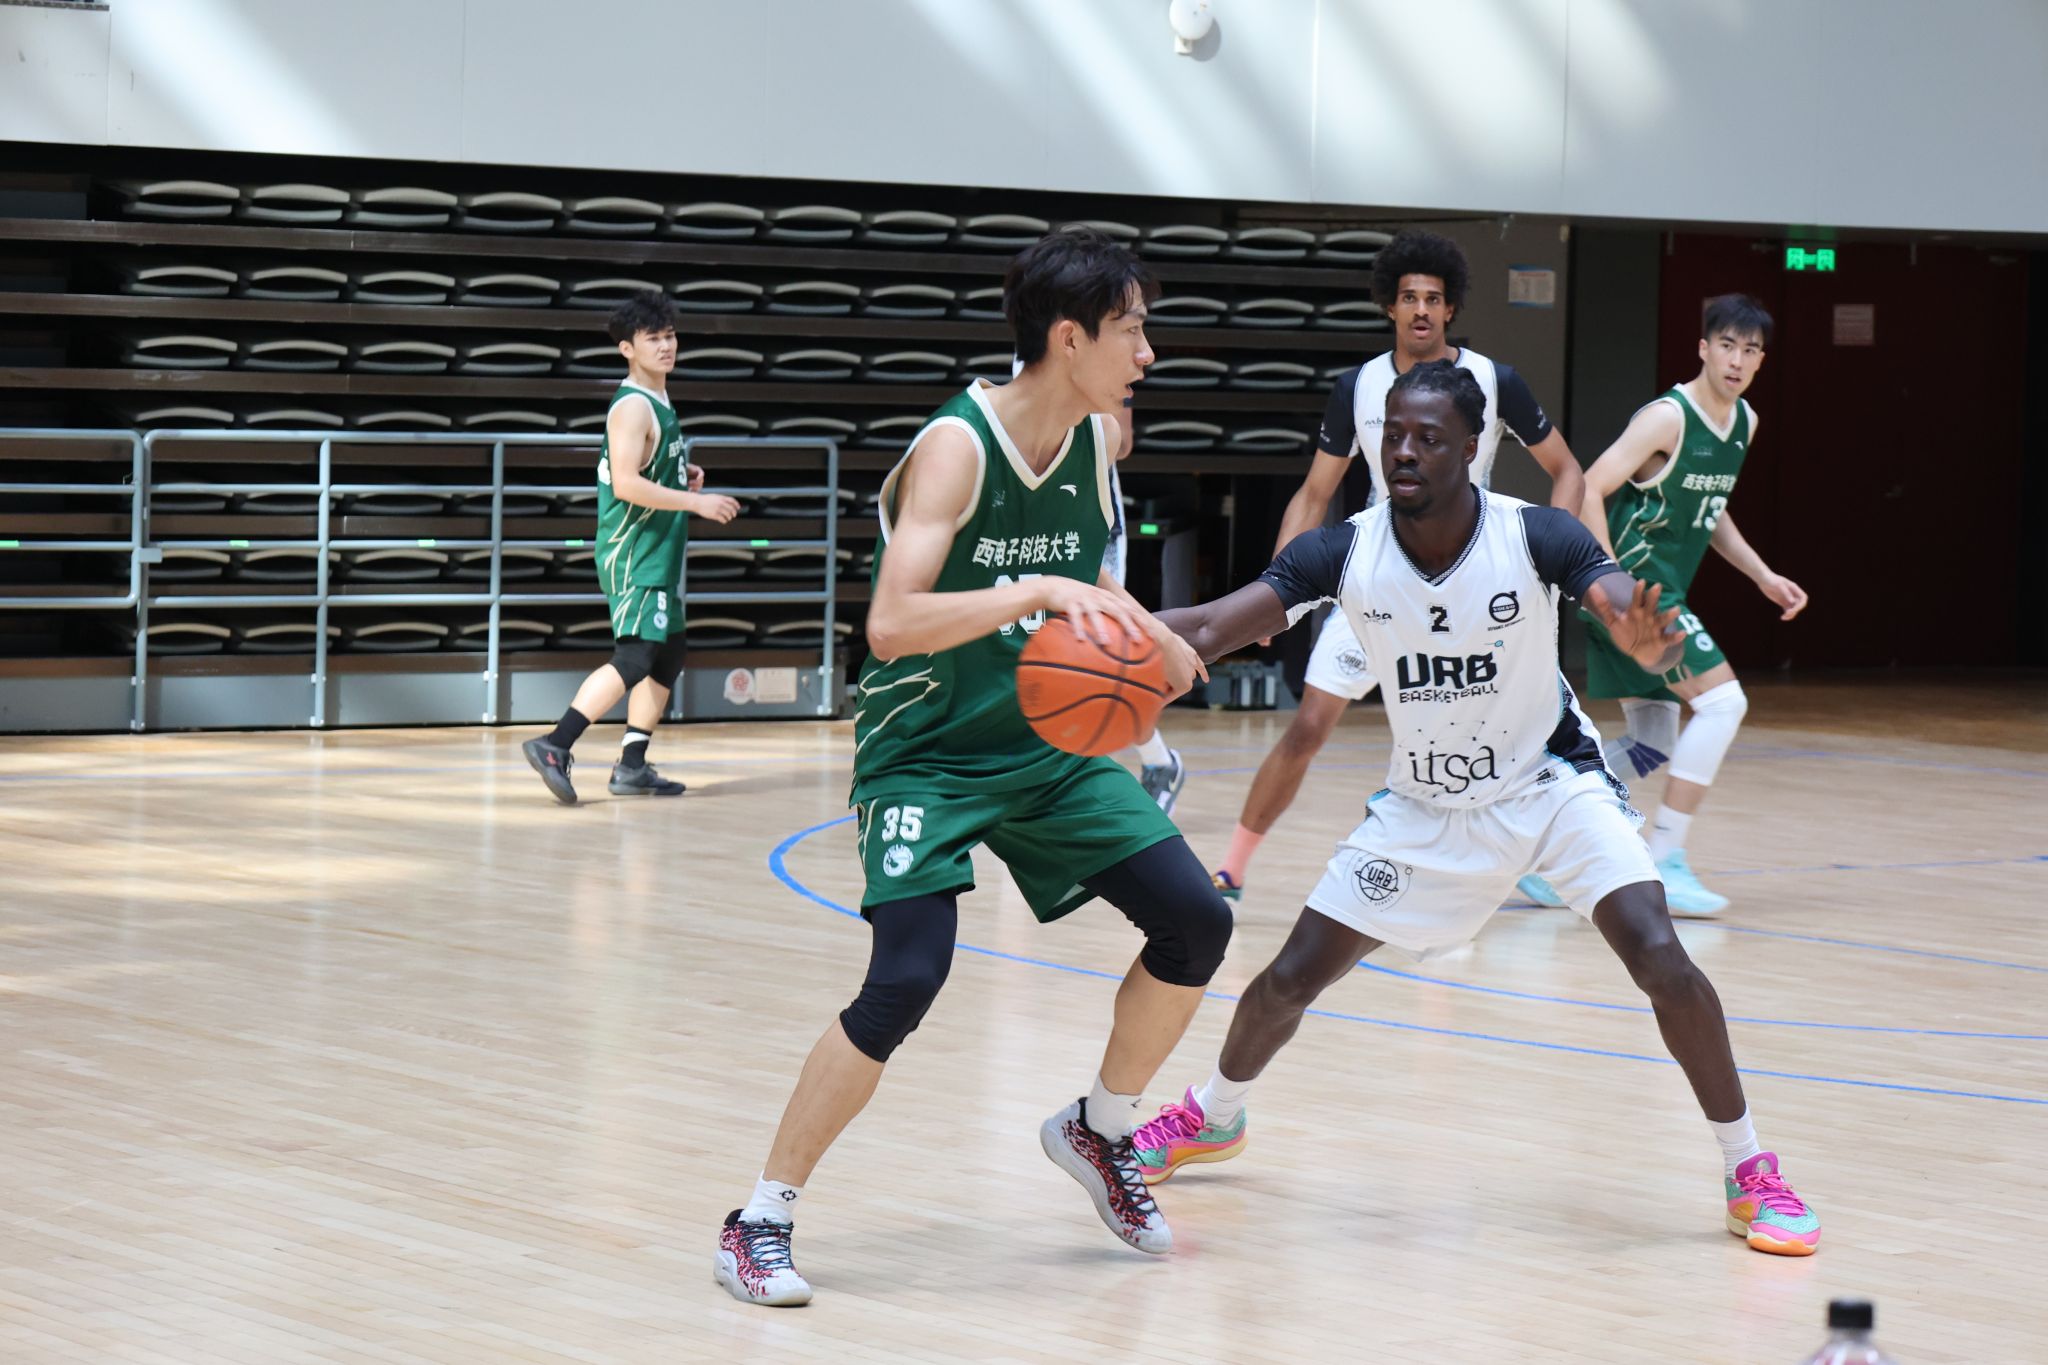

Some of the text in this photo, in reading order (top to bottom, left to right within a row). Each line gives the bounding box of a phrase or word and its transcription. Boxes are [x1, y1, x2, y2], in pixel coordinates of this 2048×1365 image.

[1692, 495, 1728, 531] 13
[657, 590, 667, 611] 5
[1429, 605, 1450, 632] 2
[1396, 651, 1498, 690] URB
[1399, 683, 1498, 703] BASKETBALL
[1408, 746, 1500, 794] itsa
[881, 805, 924, 842] 35
[1367, 866, 1393, 888] URB
